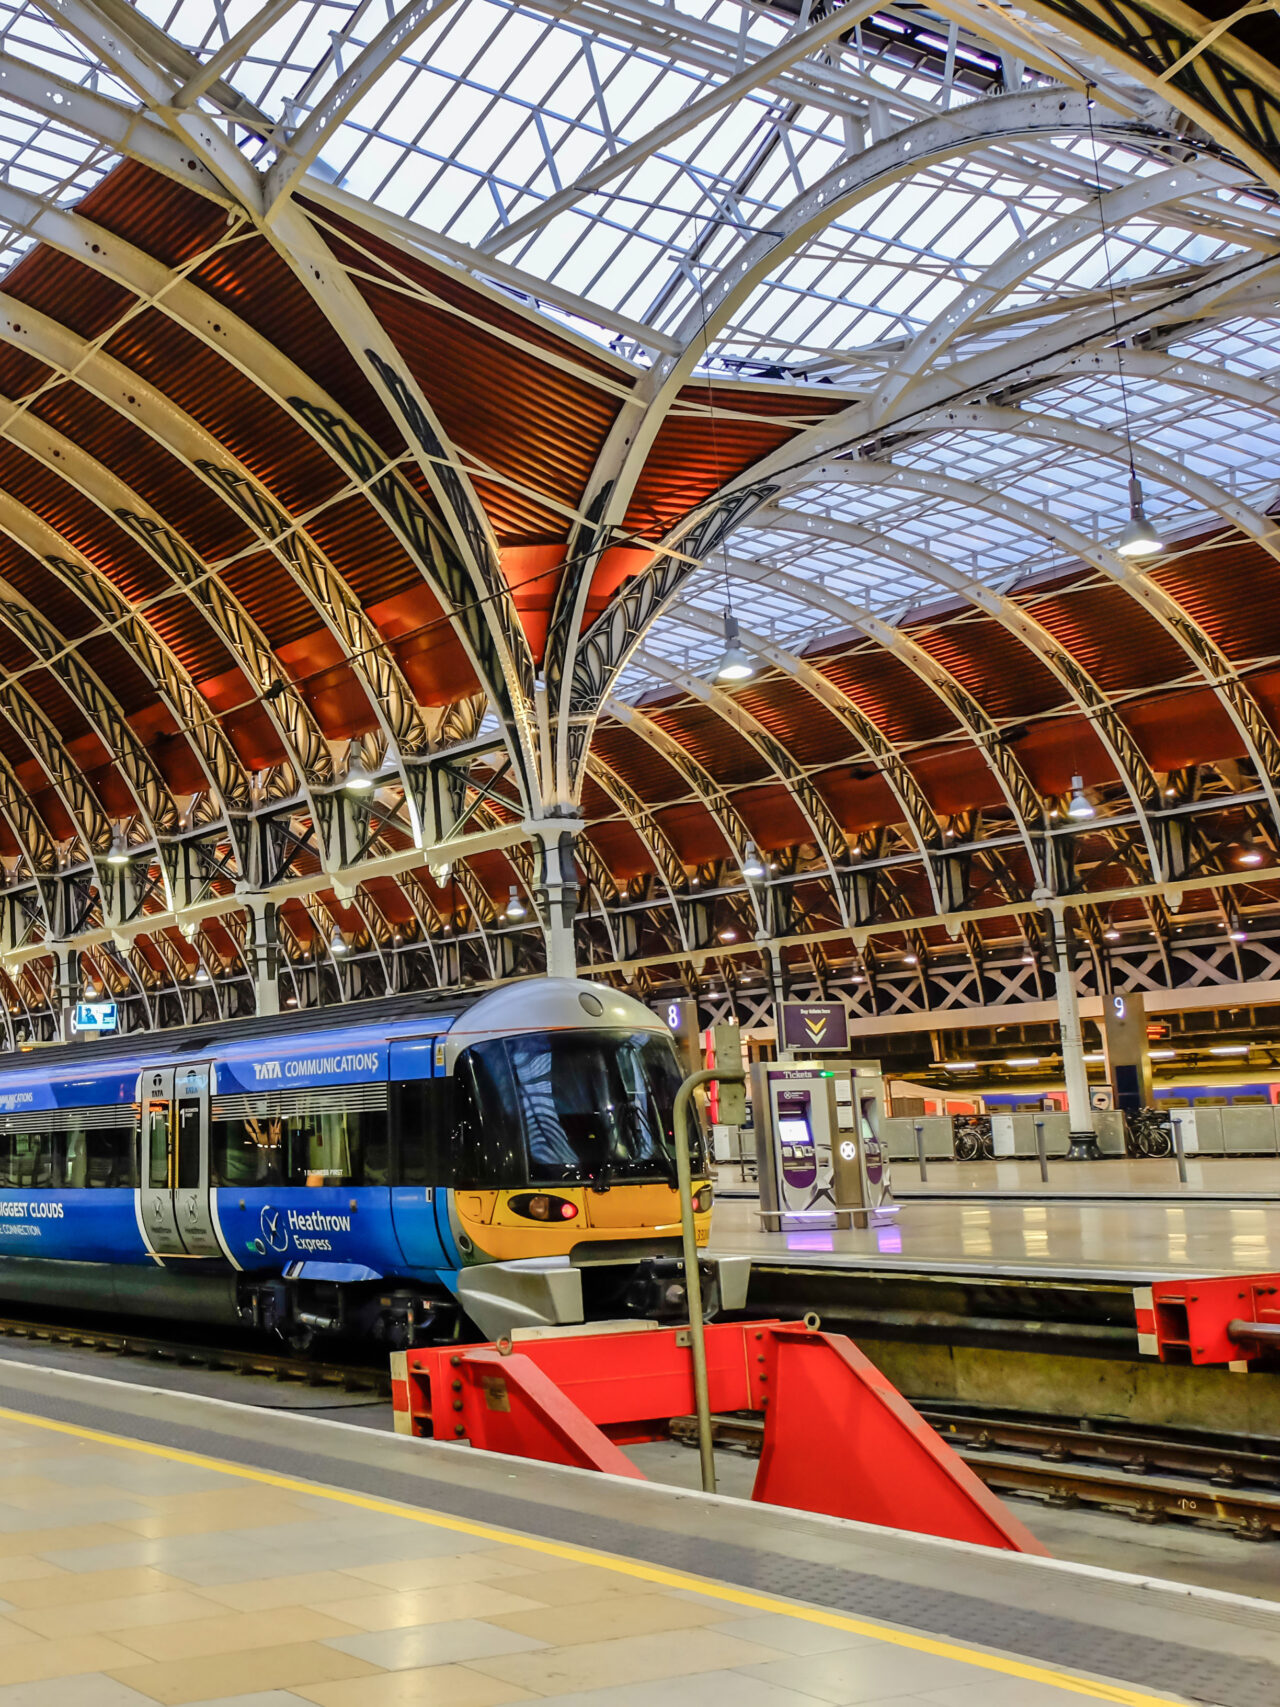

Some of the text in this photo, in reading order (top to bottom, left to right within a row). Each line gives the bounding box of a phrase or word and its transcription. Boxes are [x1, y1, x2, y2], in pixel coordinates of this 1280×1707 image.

[668, 1004, 678, 1028] 8
[1114, 996, 1124, 1018] 9
[252, 1052, 378, 1080] TATA COMMUNICATIONS
[783, 1071, 812, 1079] Tickets
[30, 1203, 64, 1218] CLOUDS
[287, 1209, 351, 1231] Heathrow
[293, 1234, 332, 1253] Express
